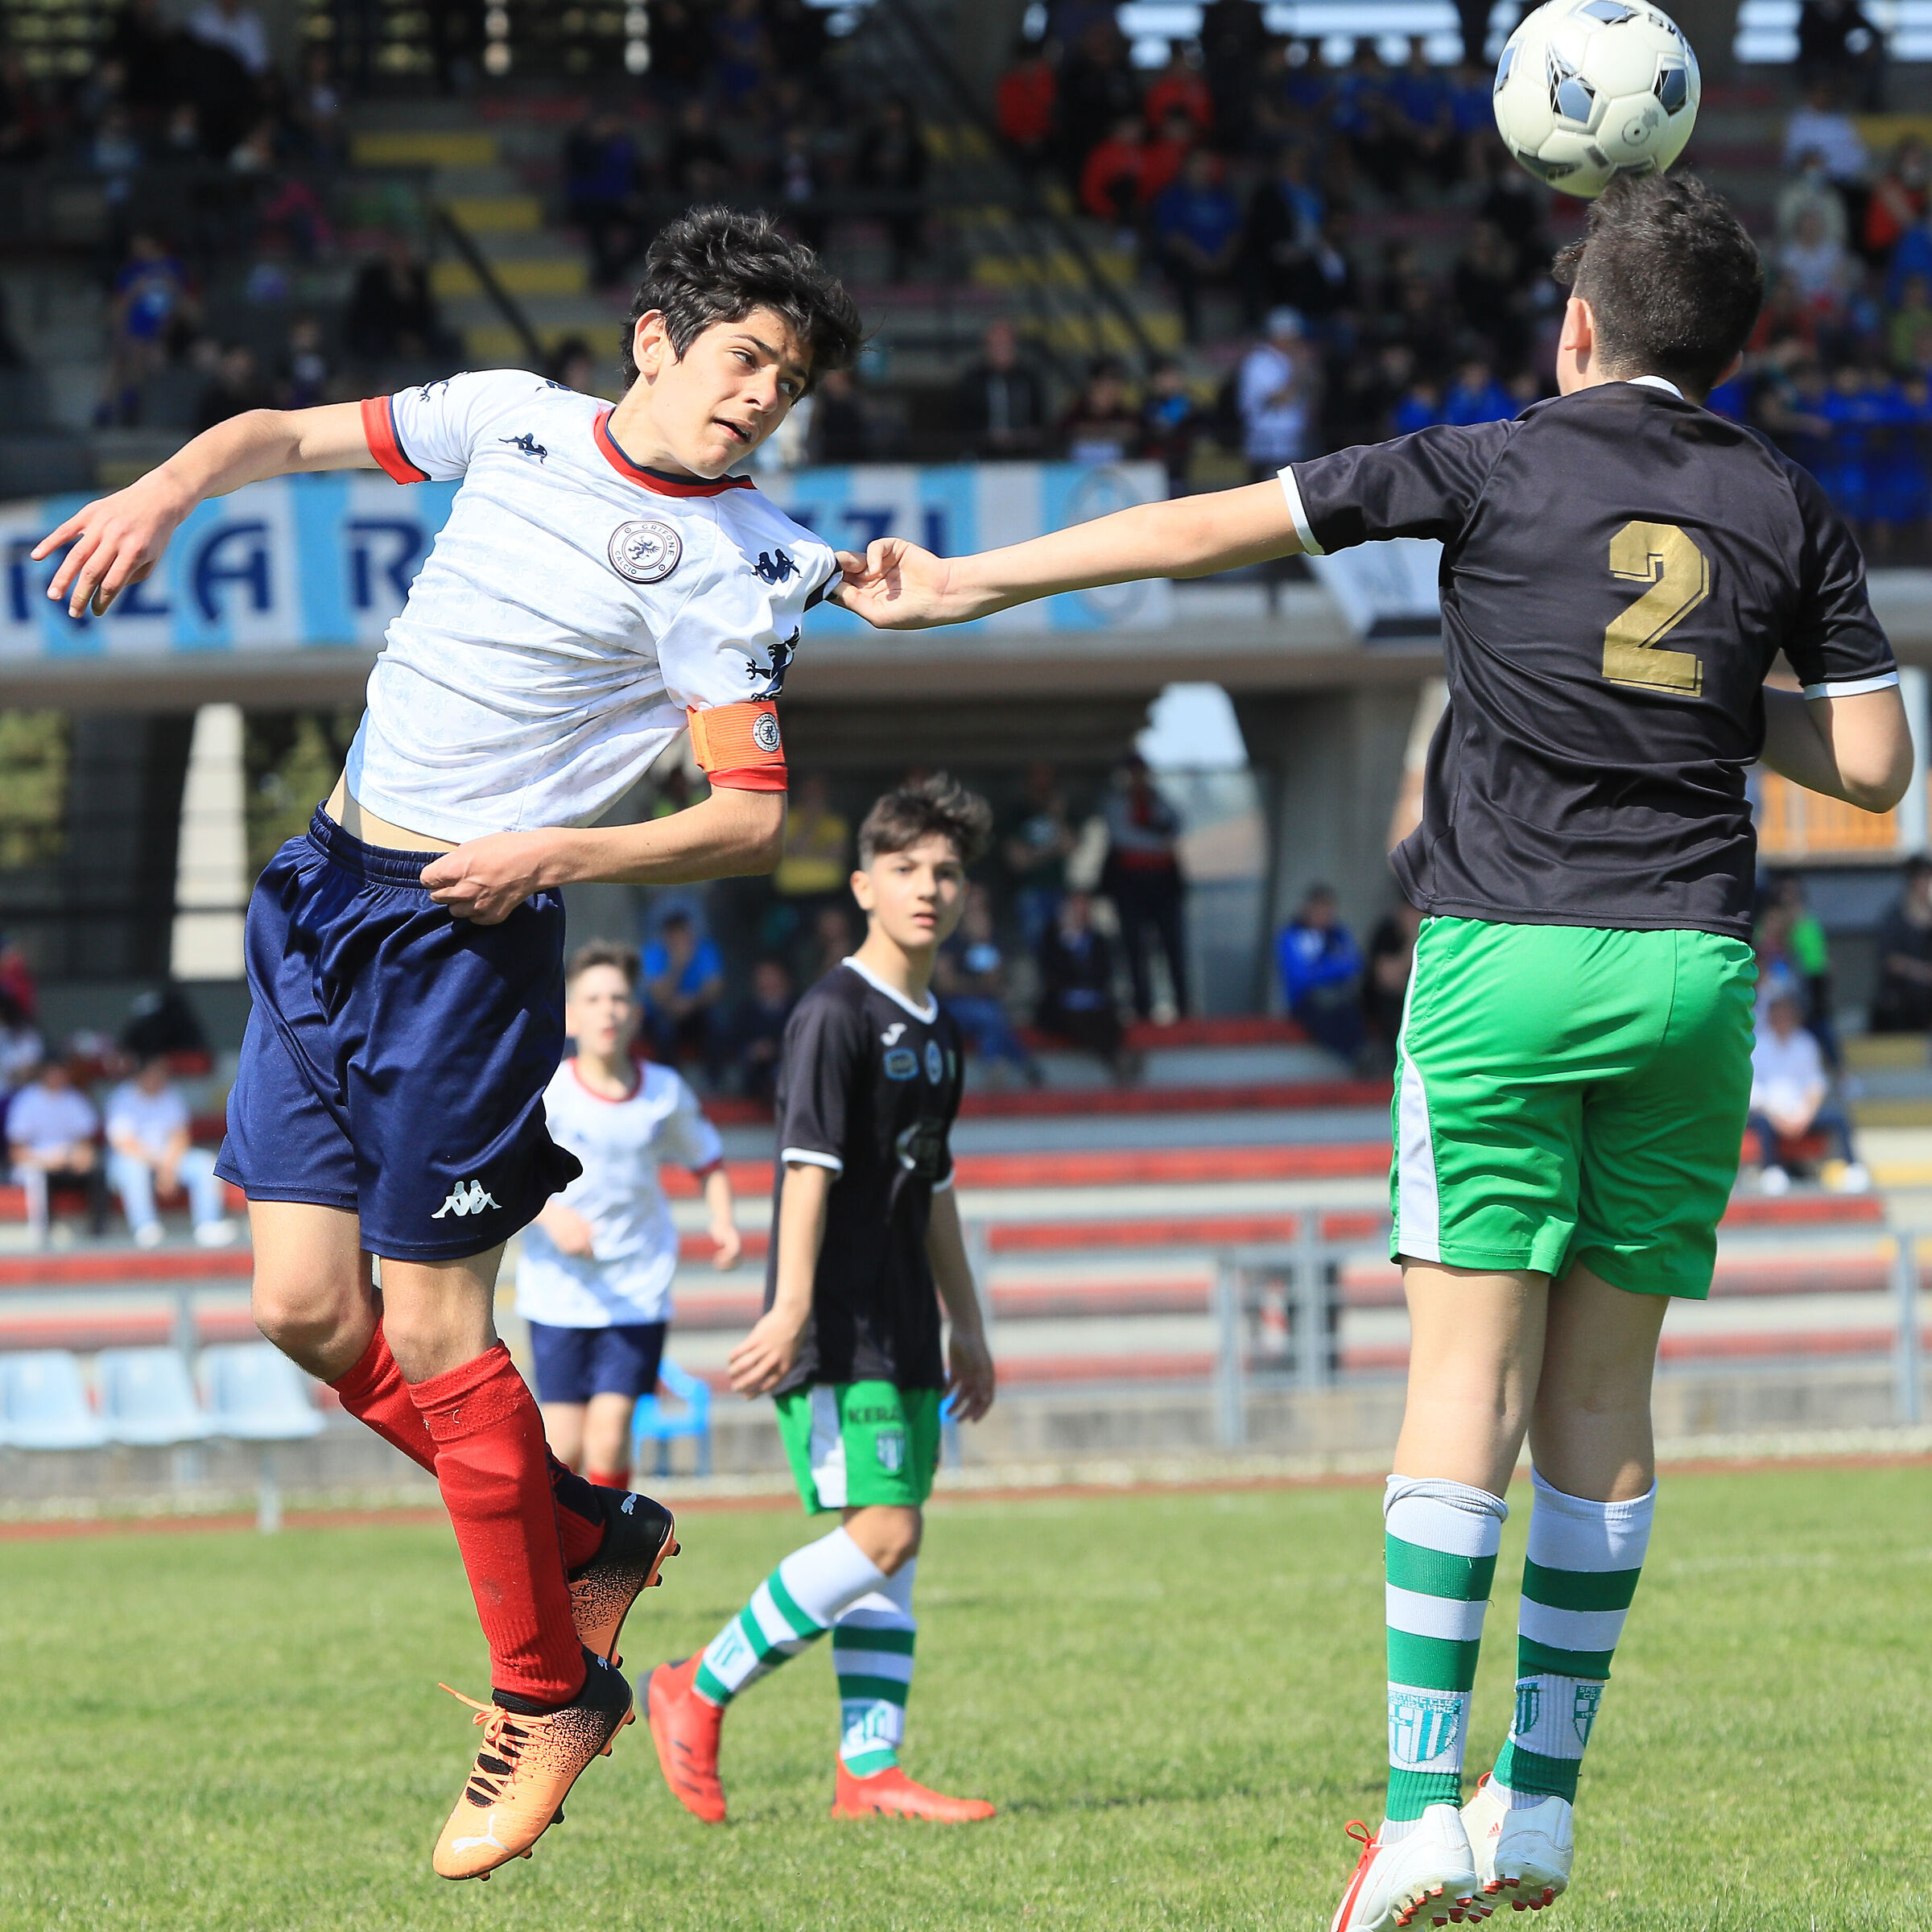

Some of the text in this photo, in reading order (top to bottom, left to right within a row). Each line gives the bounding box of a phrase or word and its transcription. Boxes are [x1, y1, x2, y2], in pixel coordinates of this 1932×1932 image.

[642, 523, 675, 556] GRIFONE
[614, 551, 638, 575] CALCIO
[1602, 520, 1710, 698] 2
